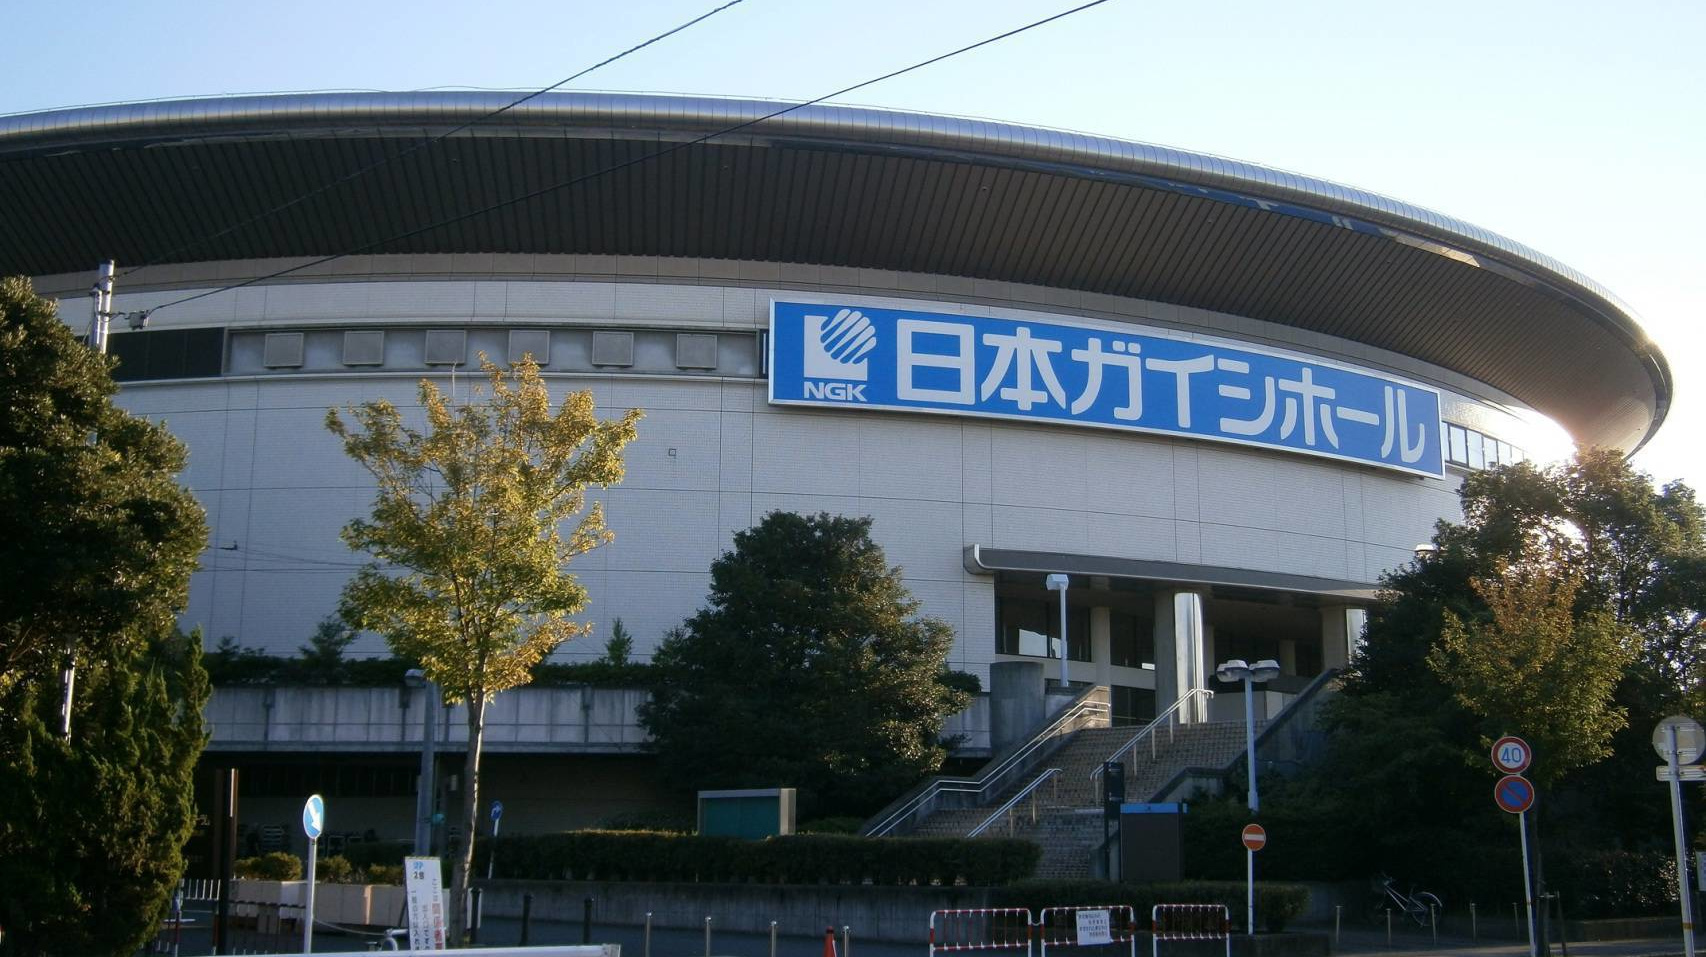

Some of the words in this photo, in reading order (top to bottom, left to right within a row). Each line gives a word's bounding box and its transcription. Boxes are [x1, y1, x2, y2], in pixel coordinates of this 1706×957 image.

[803, 381, 868, 402] NGK
[896, 318, 1426, 464] 日本ガイシホール
[1501, 747, 1522, 763] 40
